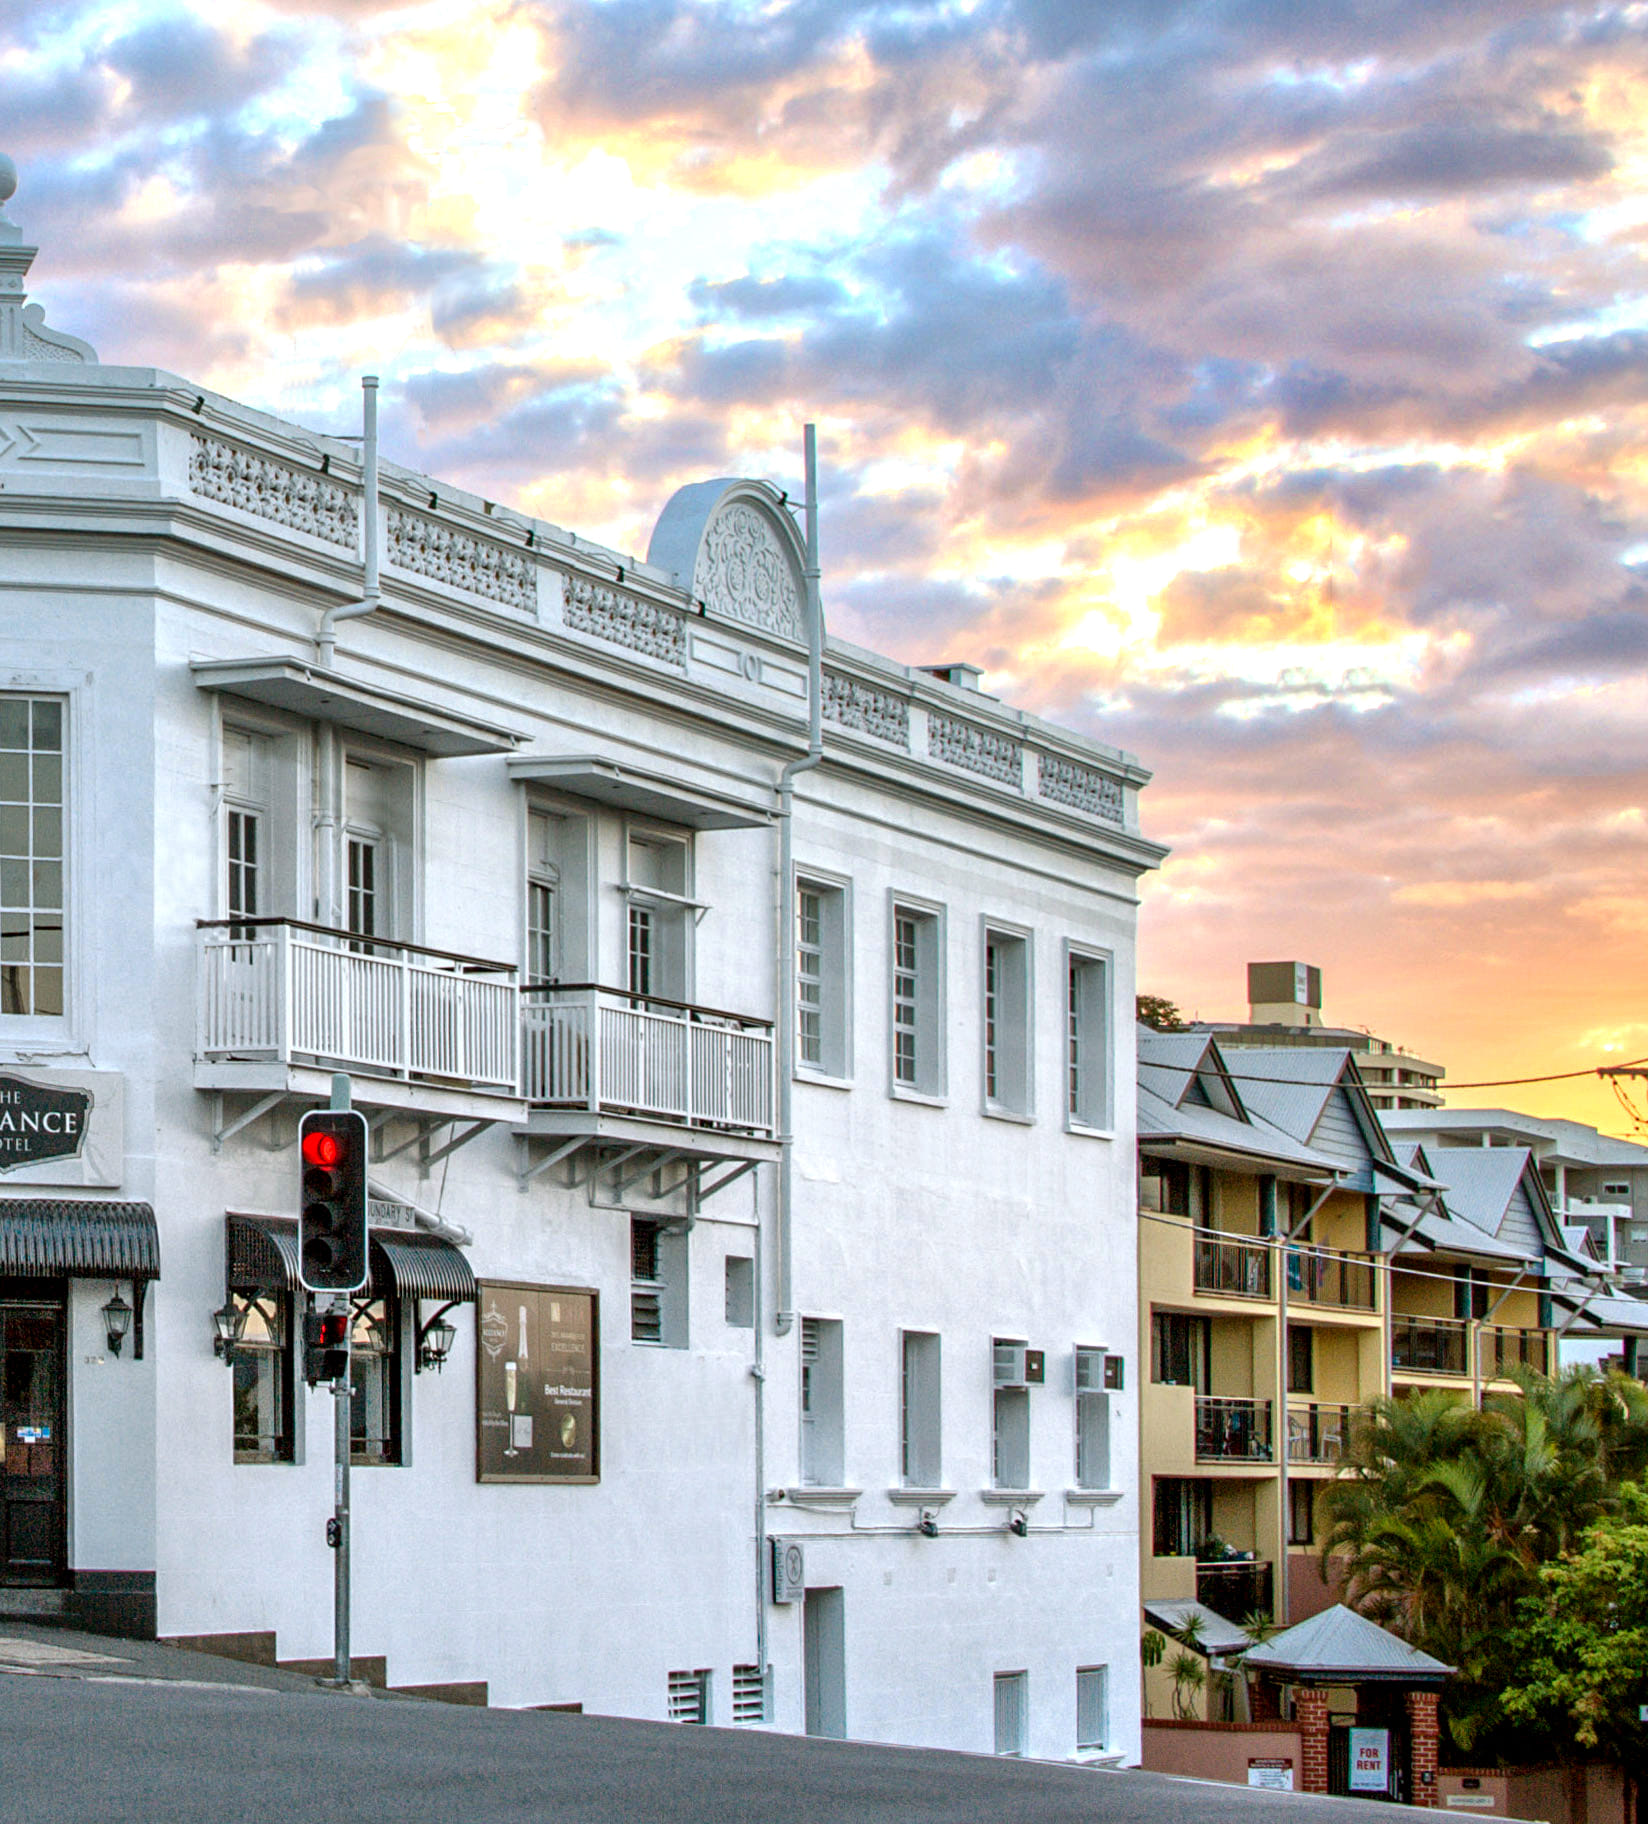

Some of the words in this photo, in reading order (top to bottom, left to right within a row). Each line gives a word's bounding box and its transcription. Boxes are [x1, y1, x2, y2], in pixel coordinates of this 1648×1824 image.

[544, 1384, 558, 1396] Best
[559, 1385, 592, 1398] Restaurant
[1359, 1747, 1380, 1759] FOR
[1356, 1759, 1382, 1771] RENT
